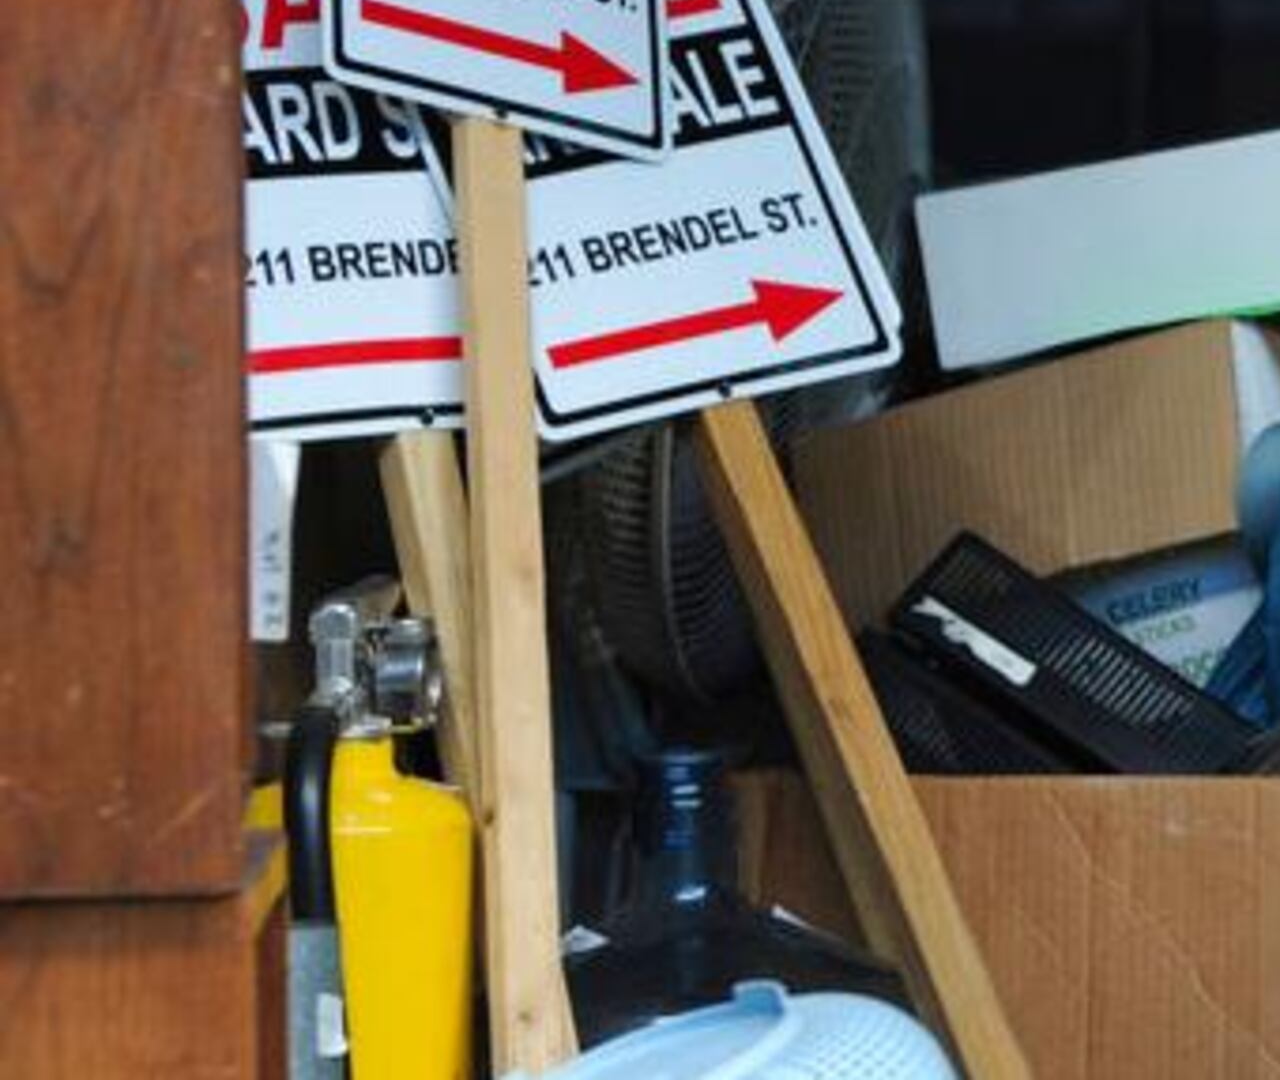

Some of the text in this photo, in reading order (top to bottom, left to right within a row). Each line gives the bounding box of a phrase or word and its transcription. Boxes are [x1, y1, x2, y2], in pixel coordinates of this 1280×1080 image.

[242, 80, 361, 164] ARD
[664, 38, 780, 133] ALE
[580, 206, 760, 273] BRENDEL
[760, 193, 818, 235] ST.
[1105, 577, 1200, 622] CELERY
